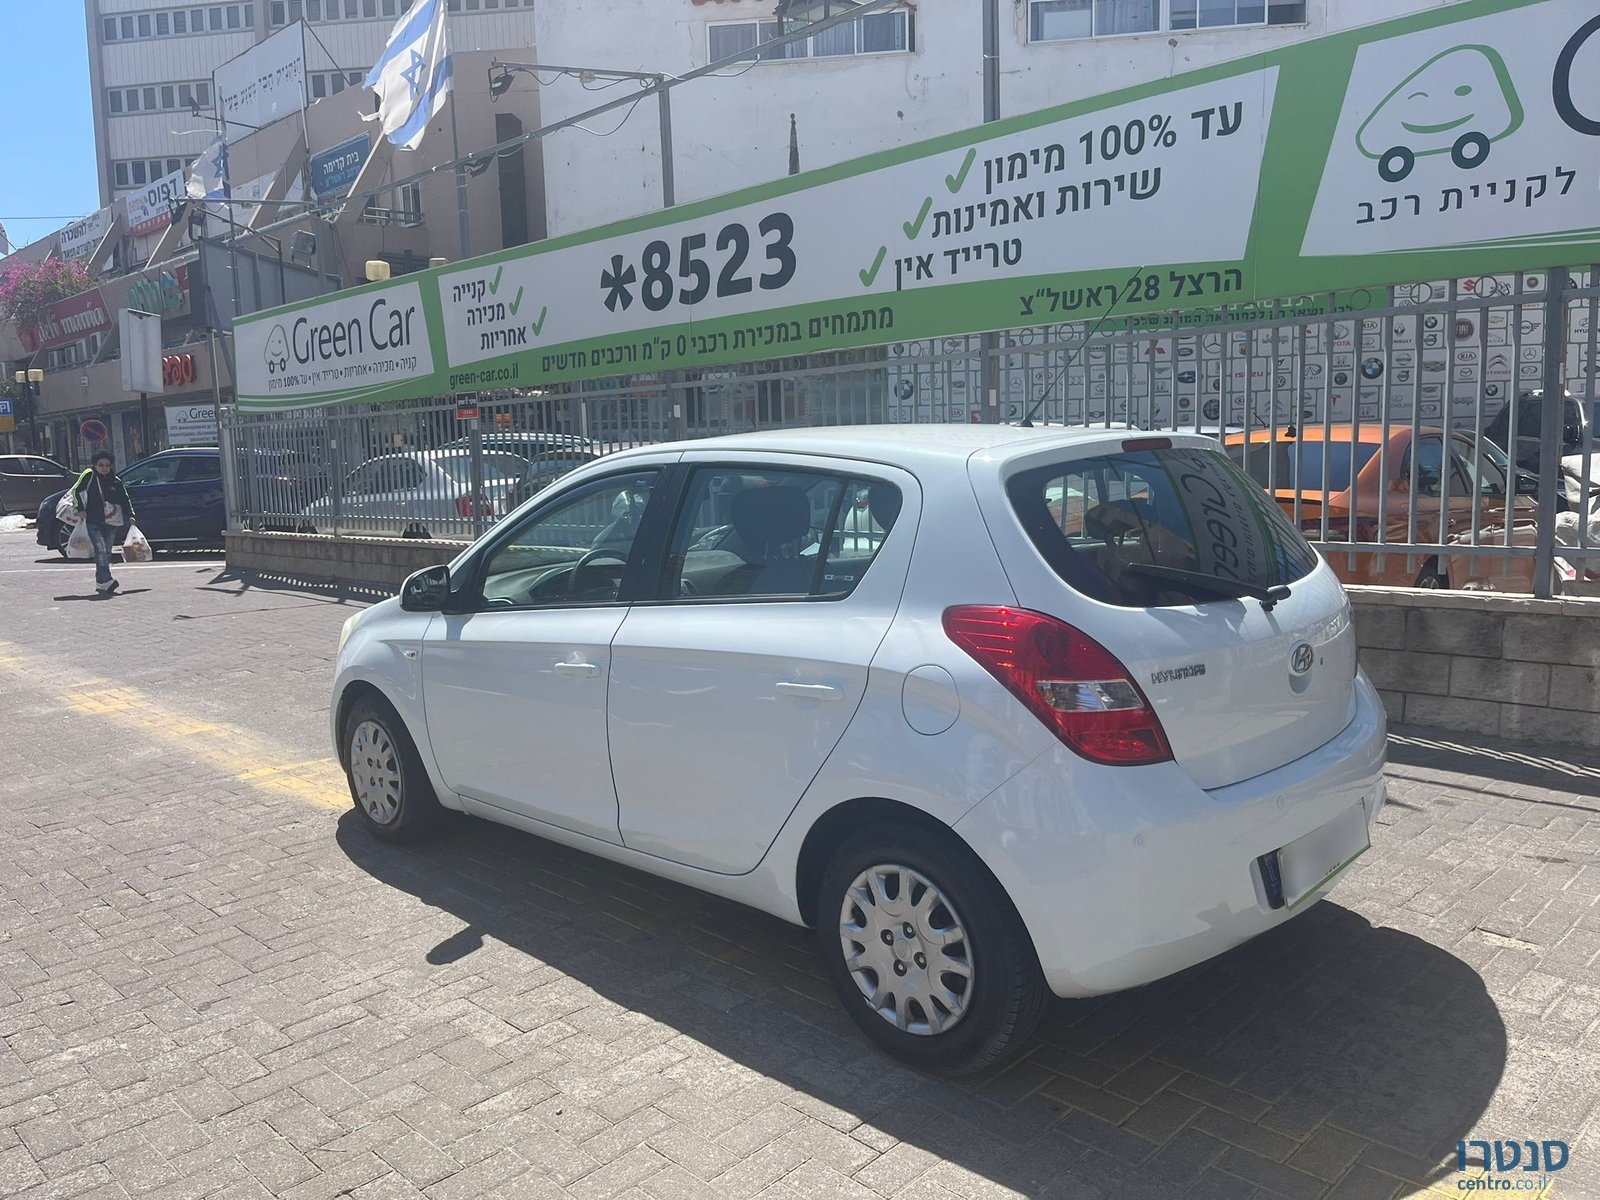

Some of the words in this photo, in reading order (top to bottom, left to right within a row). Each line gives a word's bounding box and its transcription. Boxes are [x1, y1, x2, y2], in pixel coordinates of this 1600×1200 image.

[1191, 101, 1243, 141] עד
[1079, 113, 1177, 165] 100%
[323, 157, 345, 175] קדימה
[346, 152, 359, 166] בית
[984, 143, 1066, 195] מימון
[148, 178, 177, 207] דפוס
[1056, 167, 1162, 216] שירות
[1439, 166, 1576, 213] לקניית
[932, 190, 1045, 239] ואמינות
[1356, 194, 1421, 224] רכב
[61, 220, 87, 244] להשכרה
[943, 237, 1023, 275] טרייד
[895, 251, 934, 292] אין
[1169, 268, 1242, 298] הרצל
[453, 280, 486, 303] קנייה
[1019, 285, 1117, 316] ראשל"צ
[1126, 274, 1160, 303] 28
[467, 302, 506, 326] מכירה
[809, 306, 894, 338] מתמחים
[292, 317, 363, 365] Green
[369, 298, 416, 351] Car
[481, 326, 527, 351] אחריות
[691, 332, 728, 354] רכבי
[733, 321, 802, 350] במכירת
[591, 344, 637, 366] ורכבים
[642, 336, 671, 360] ק"מ
[677, 334, 687, 357] 0
[344, 364, 367, 378] אחריות
[373, 359, 394, 374] מכירה
[400, 356, 417, 372] קניה
[542, 351, 587, 372] חדשים
[268, 378, 283, 392] מימון
[283, 375, 299, 388] 100%
[300, 374, 308, 385] עד
[312, 371, 321, 386] אין
[322, 369, 339, 381] טרייד
[449, 362, 519, 390] green-car.co.il
[1151, 664, 1206, 684] HYUNDAI
